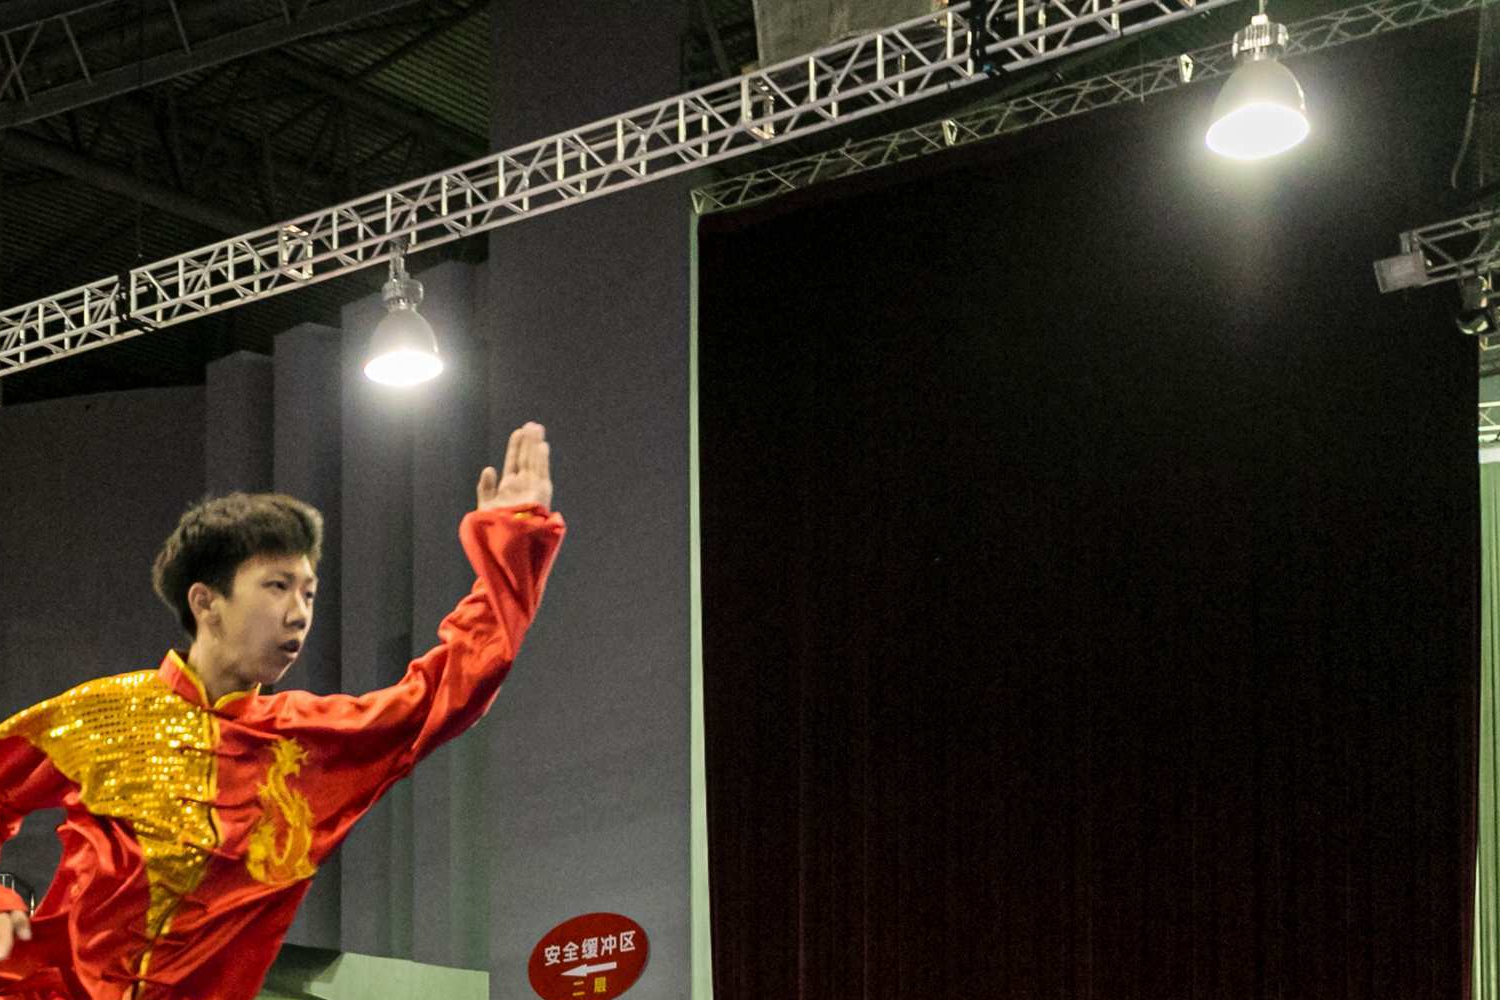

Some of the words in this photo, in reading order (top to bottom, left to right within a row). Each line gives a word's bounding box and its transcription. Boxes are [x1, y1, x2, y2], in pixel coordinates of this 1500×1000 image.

[544, 930, 636, 966] 安全缓冲区
